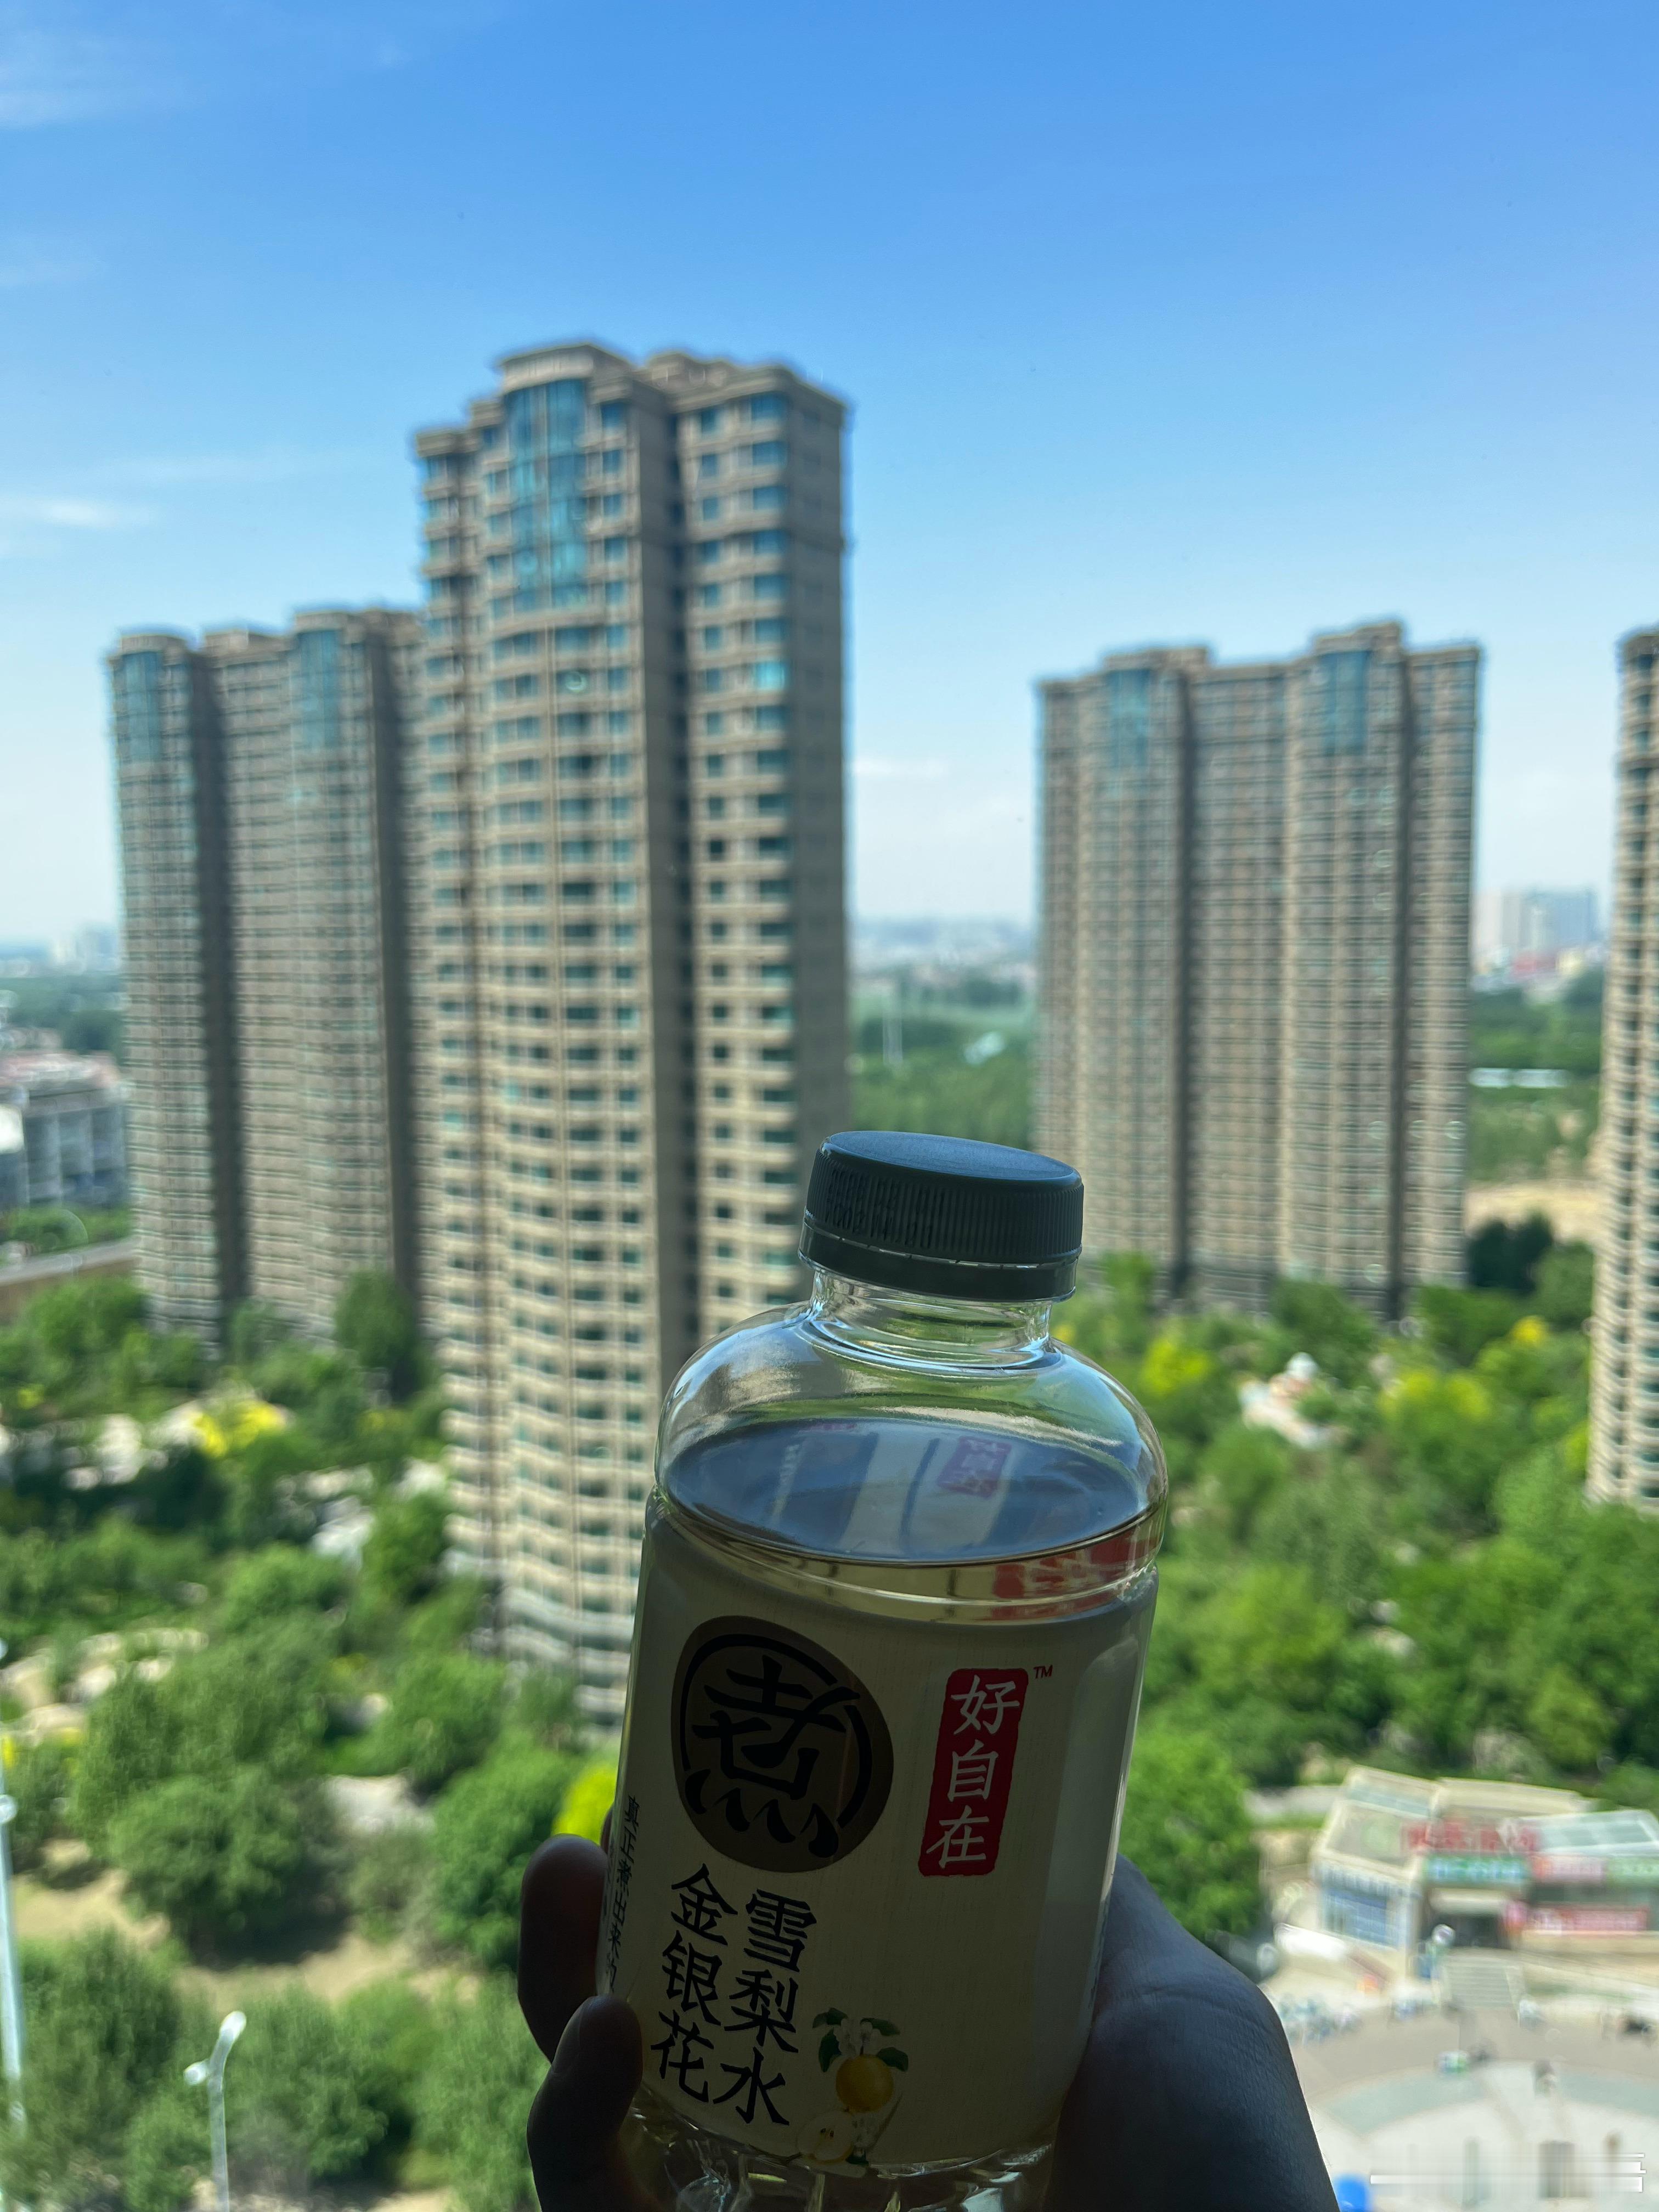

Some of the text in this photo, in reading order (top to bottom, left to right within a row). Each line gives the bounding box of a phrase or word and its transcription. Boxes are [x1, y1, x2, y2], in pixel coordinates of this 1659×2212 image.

[927, 1674, 1021, 1869] 好自在
[1033, 1664, 1054, 1680] TM
[650, 1863, 738, 2103] 金银花
[712, 1888, 817, 2126] 雪梨水
